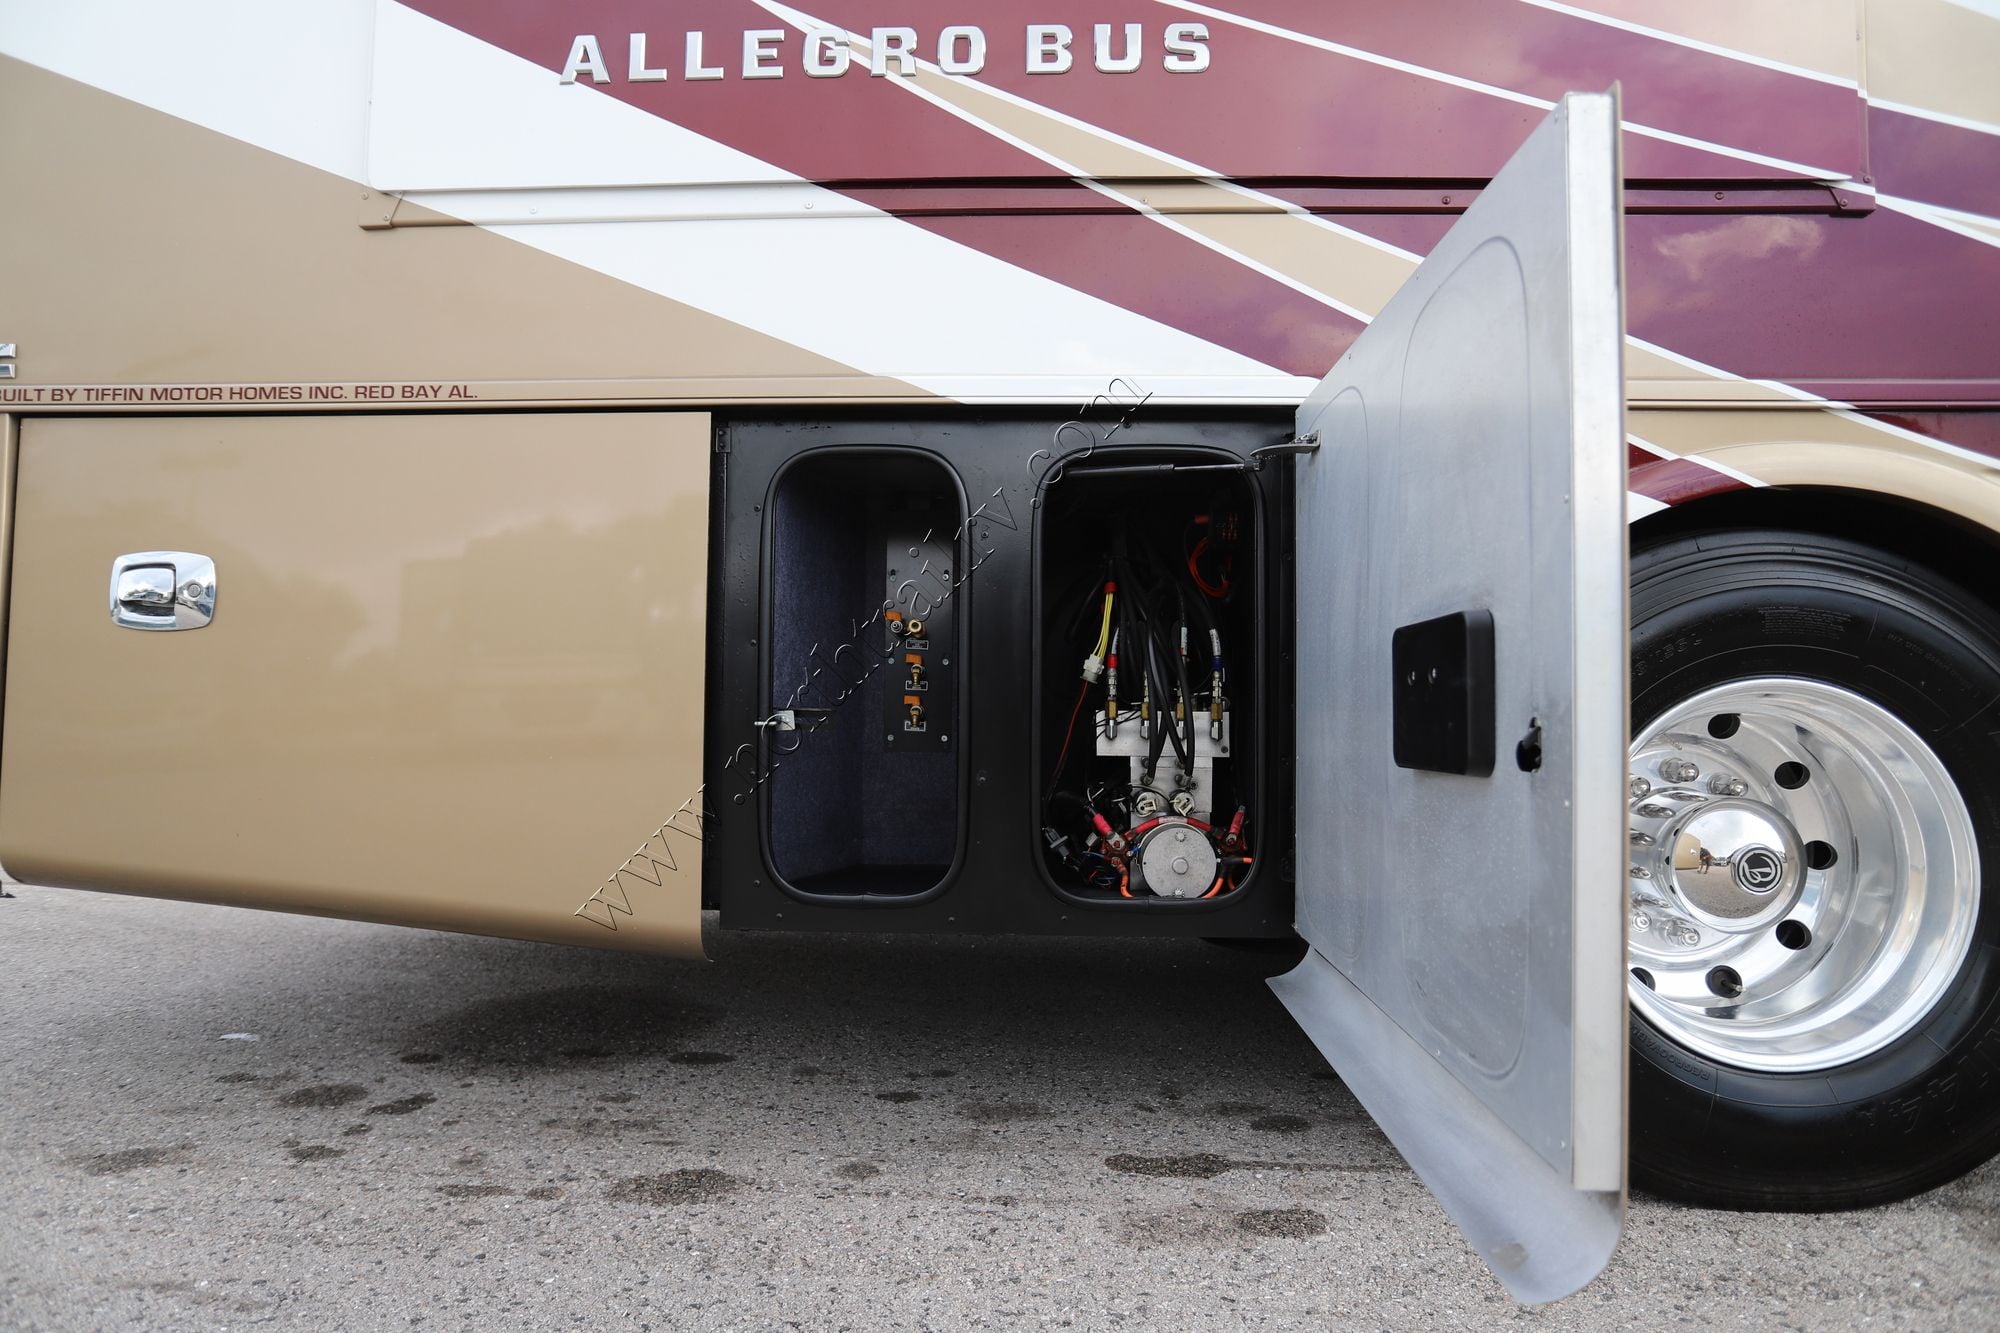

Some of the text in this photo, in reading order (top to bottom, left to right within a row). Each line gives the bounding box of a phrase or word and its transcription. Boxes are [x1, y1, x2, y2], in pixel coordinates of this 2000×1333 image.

[559, 22, 1212, 86] ALLEGRO BUS
[0, 385, 478, 402] UILT BY TIFFIN MOTOR HOMES INC. RED BAY AL.
[1630, 1022, 1711, 1081] REGROOVABL
